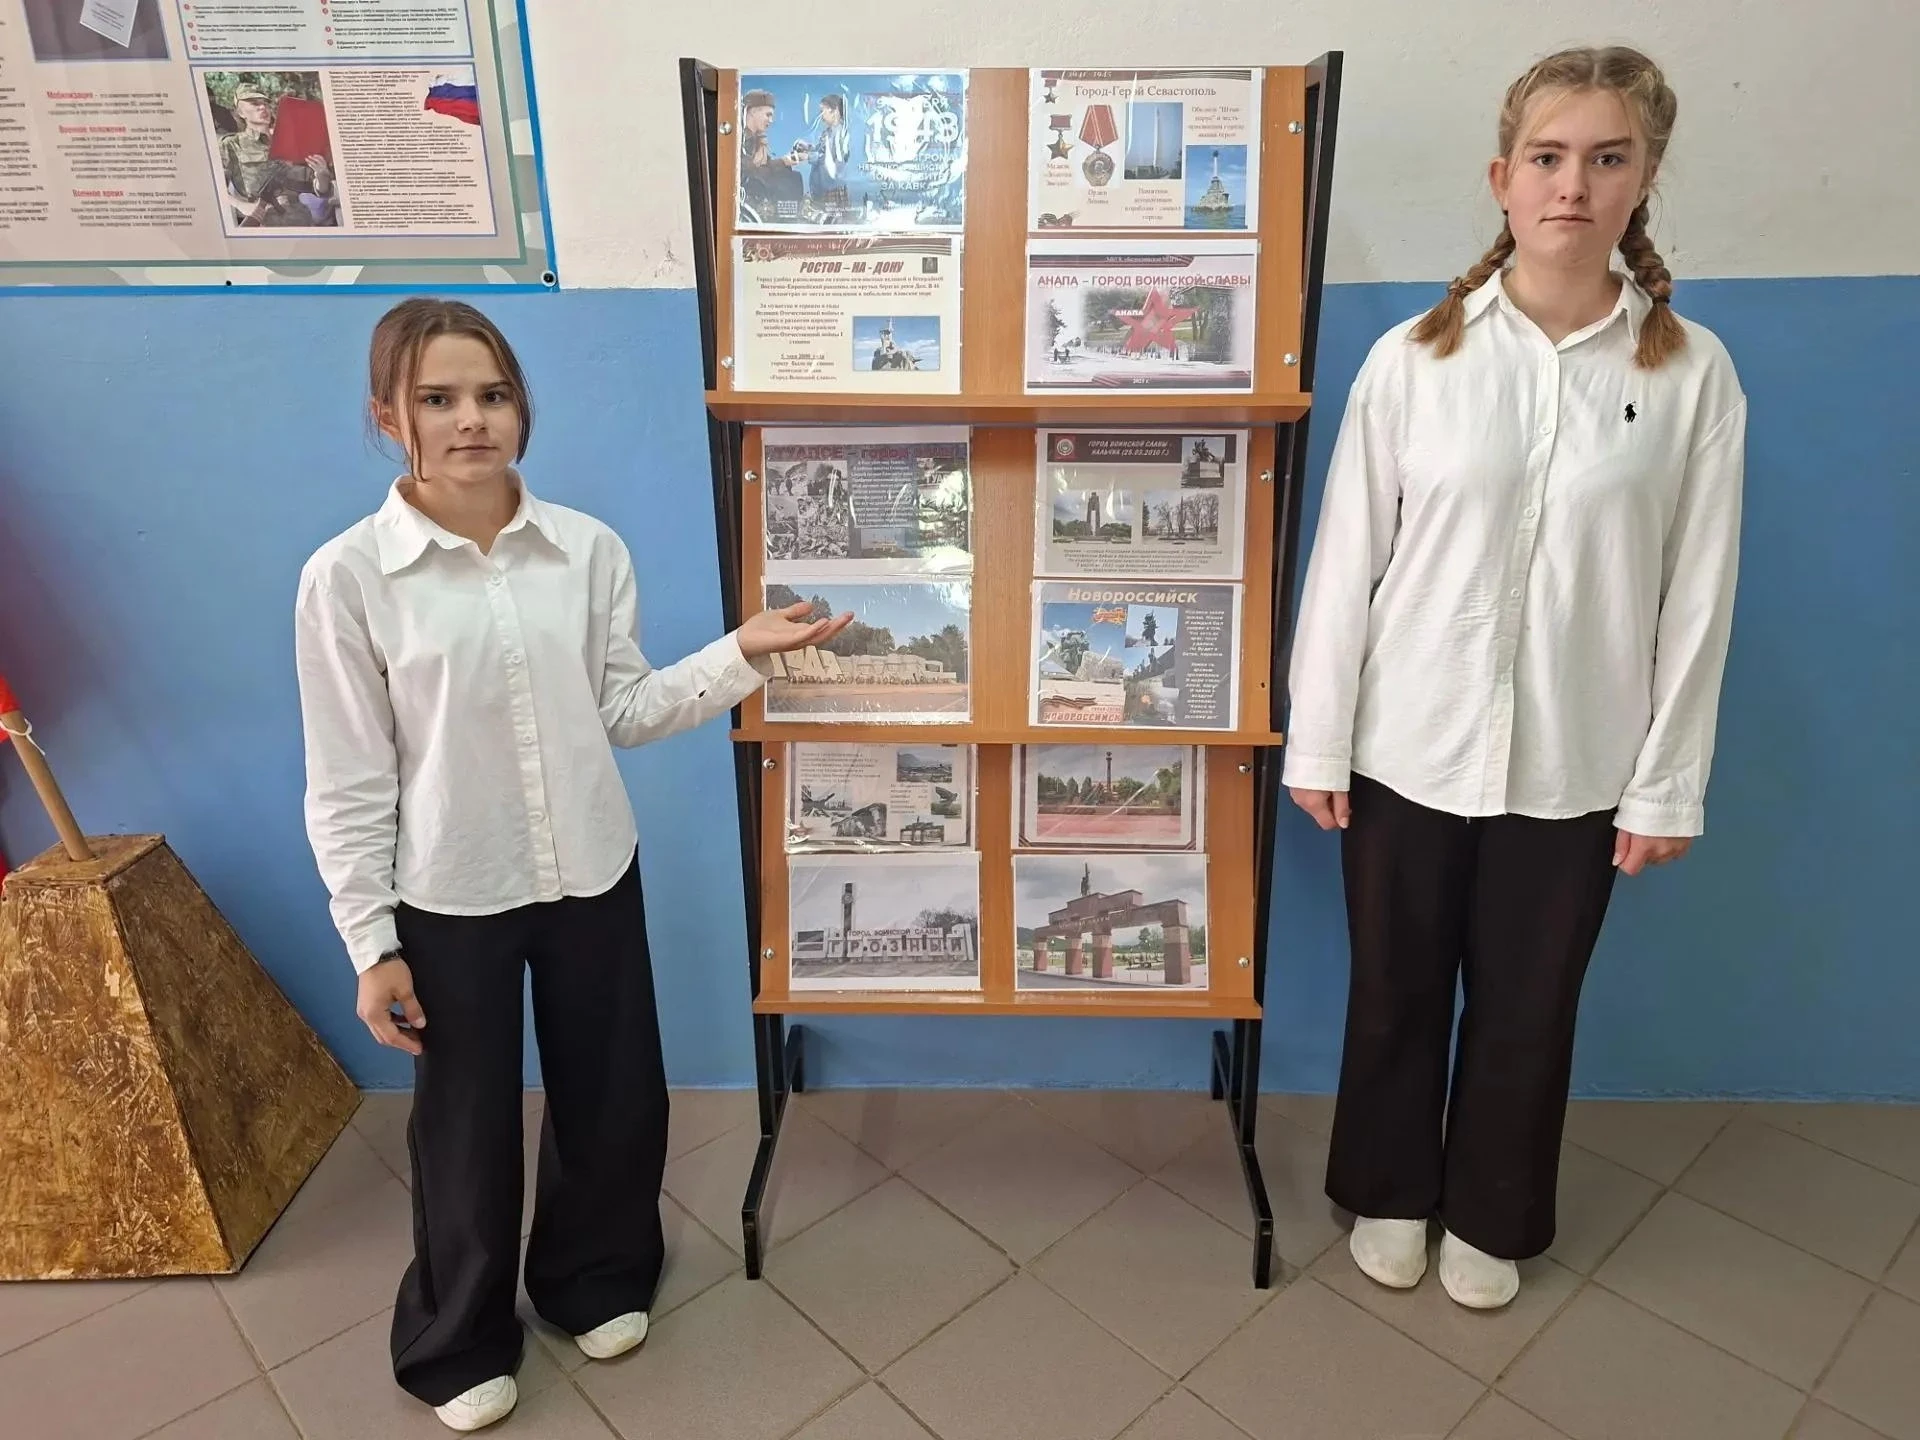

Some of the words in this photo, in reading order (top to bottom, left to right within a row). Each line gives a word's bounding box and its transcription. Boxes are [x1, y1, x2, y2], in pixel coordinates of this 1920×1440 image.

[1147, 85, 1216, 97] Севастополь
[800, 261, 842, 274] РОСТОВ
[852, 262, 866, 273] НА
[873, 261, 905, 275] ДОНУ
[1038, 275, 1079, 286] АНАПА
[1092, 275, 1132, 286] ГОРОД
[1135, 273, 1202, 286] ВОИНСКОЙ
[1205, 275, 1251, 286] СЛАВЫ
[1114, 309, 1144, 317] АНАПА
[1088, 440, 1110, 448] ГОРОД
[1067, 586, 1198, 605] Новороссийск
[1043, 710, 1122, 722] НОВОРОССИЙСК
[830, 939, 962, 954] ГРОЗНЫЙ
